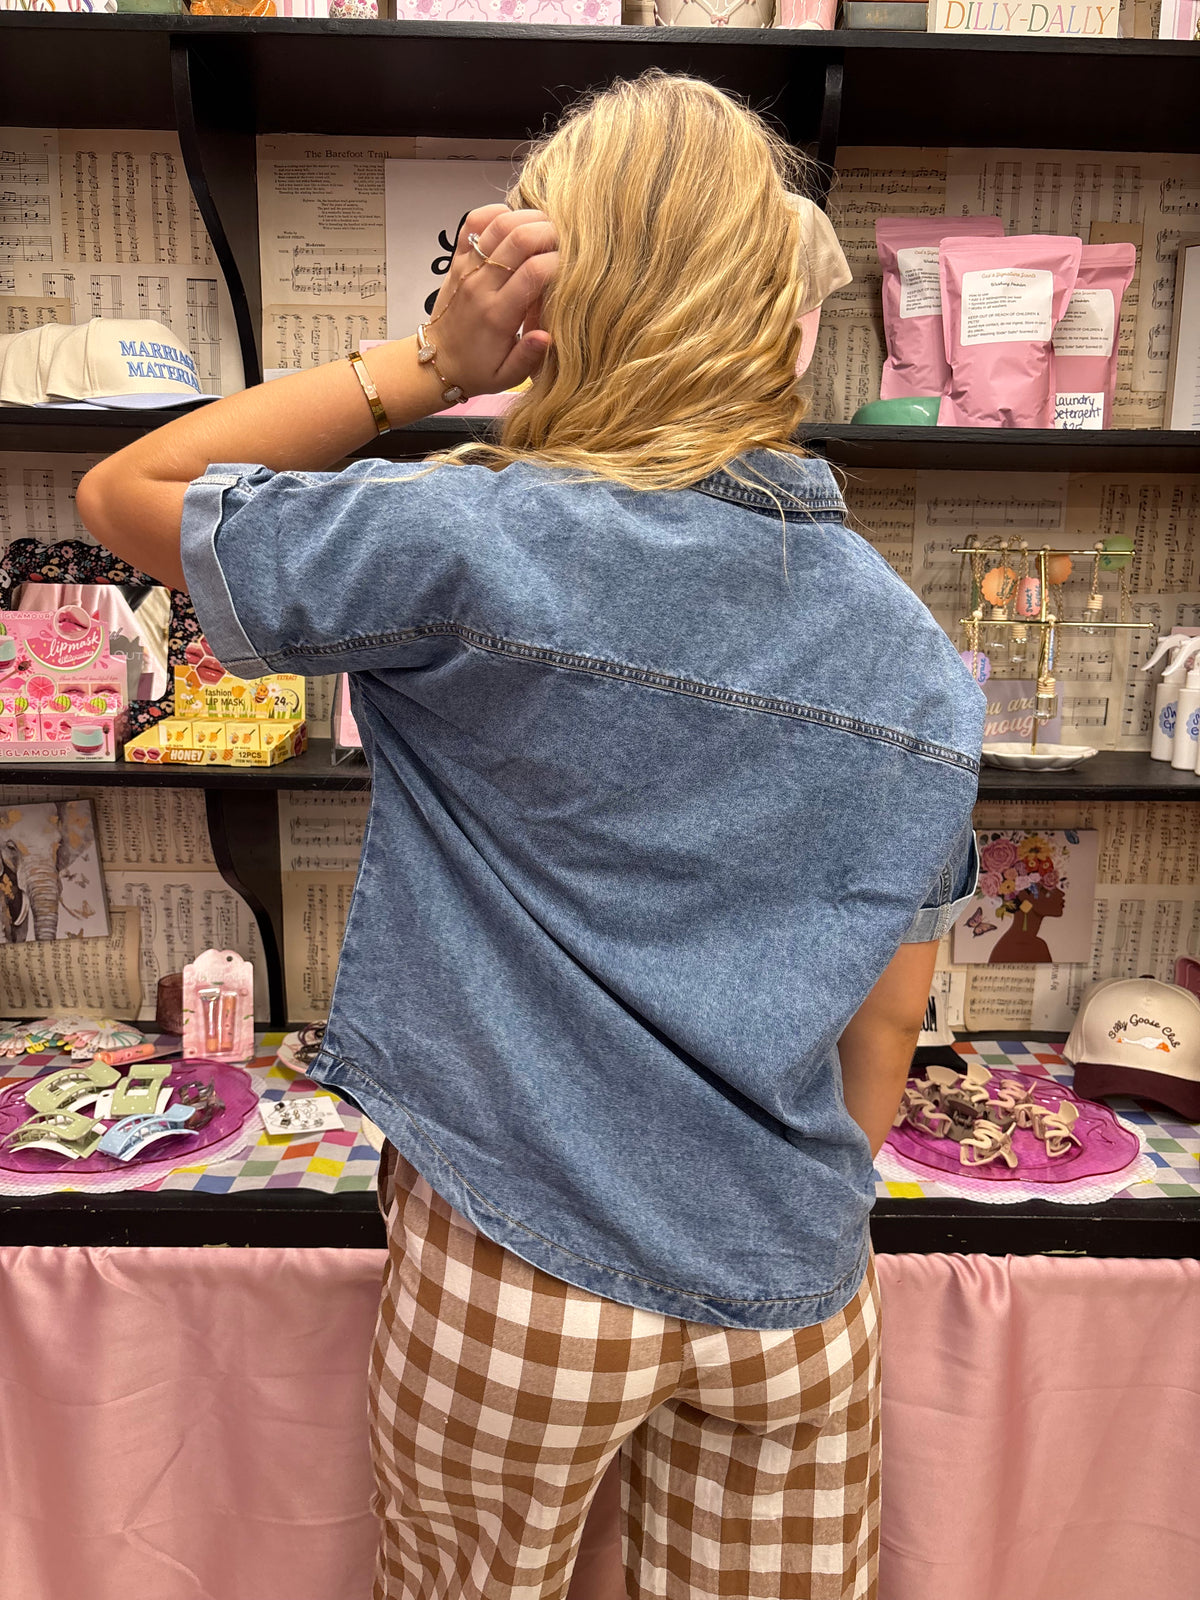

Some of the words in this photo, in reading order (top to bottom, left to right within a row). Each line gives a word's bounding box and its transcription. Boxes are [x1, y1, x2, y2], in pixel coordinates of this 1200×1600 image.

[944, 0, 1115, 35] DILLY-DALLY
[304, 150, 322, 158] The
[325, 150, 363, 158] Barefoot
[367, 150, 392, 158] Trail.
[119, 340, 197, 375] MARRIAG
[126, 361, 202, 394] MATERIA
[205, 688, 232, 697] fashion
[205, 698, 219, 706] LIP
[221, 698, 244, 706] MASK
[984, 715, 1049, 738] noug
[170, 749, 203, 761] HONEY
[238, 751, 262, 759] 12PCS
[1108, 1020, 1128, 1039] Silly
[1129, 1013, 1161, 1029] Goose
[1161, 1026, 1181, 1048] Club
